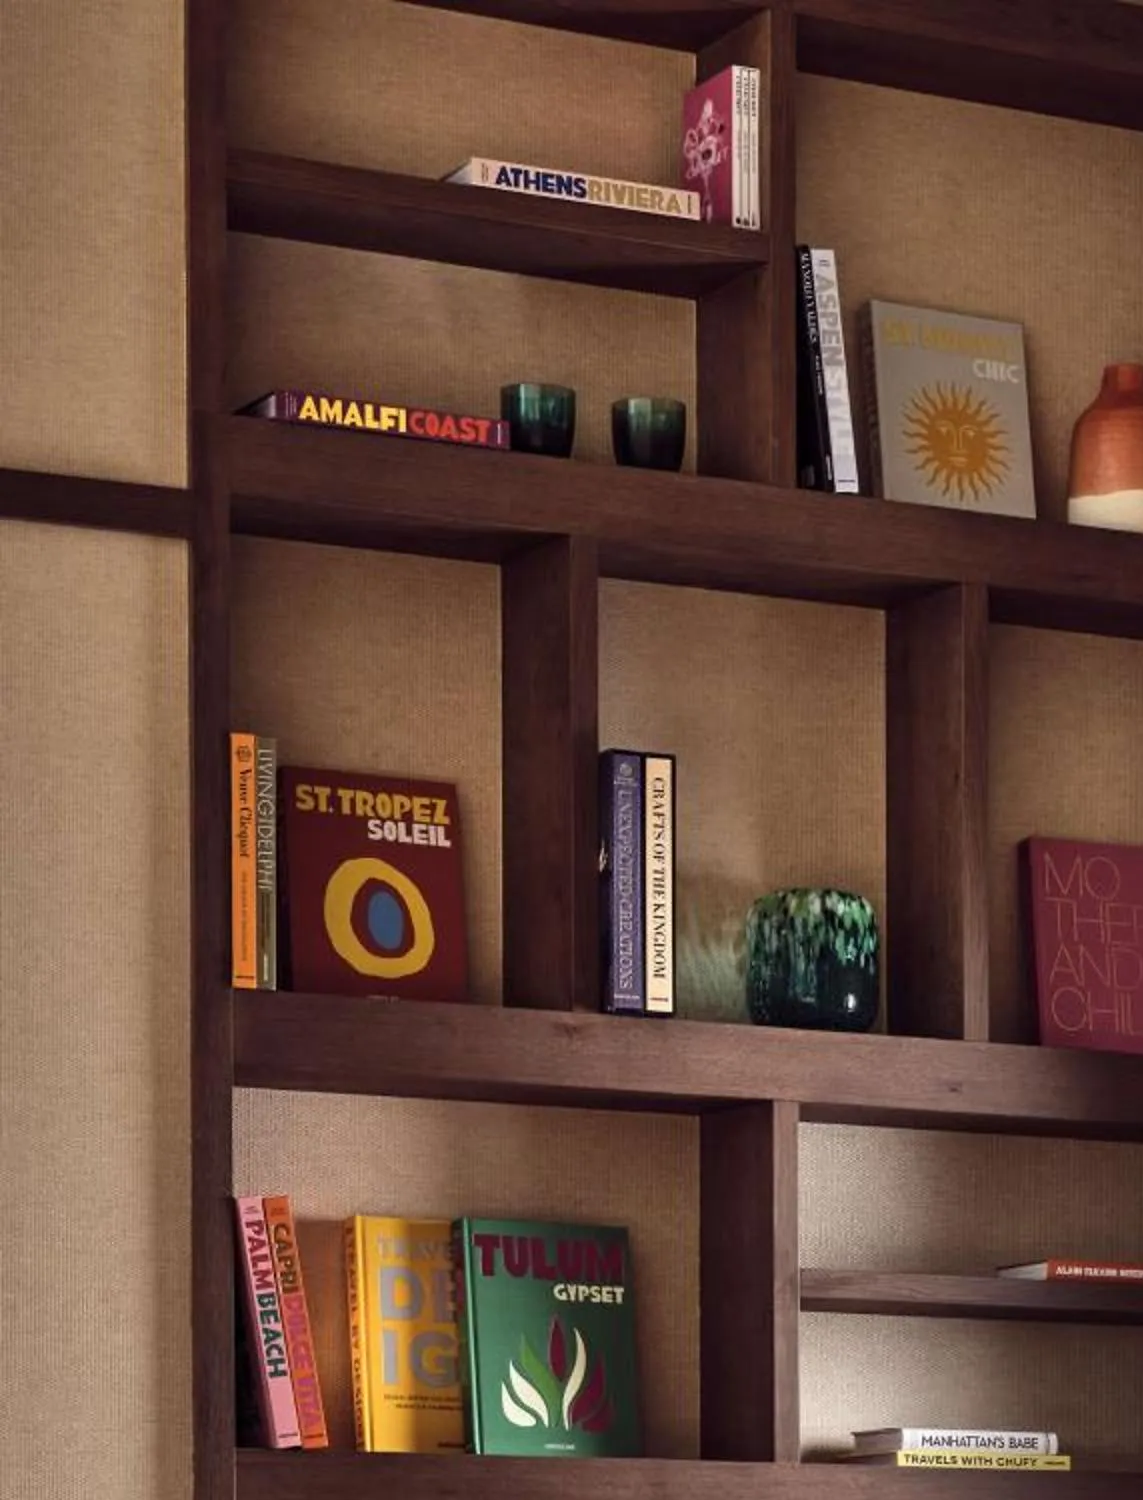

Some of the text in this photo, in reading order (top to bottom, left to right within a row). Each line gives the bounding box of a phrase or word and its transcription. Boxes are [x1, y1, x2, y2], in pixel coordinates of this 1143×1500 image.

[495, 166, 682, 214] ATHENS RIVIERA
[815, 272, 844, 366] ASPEN
[972, 358, 1021, 384] CHIC
[299, 395, 491, 443] AMALFI COAST
[239, 768, 252, 804] Veuve
[295, 784, 450, 825] ST. TROPEZ
[236, 806, 252, 858] Clicquot
[367, 819, 451, 848] SOLEIL
[653, 777, 667, 979] CRAFTS OF THE KINGDOM
[1044, 851, 1121, 901] MO
[617, 898, 634, 990] CREATIONS
[1050, 943, 1143, 991] AND
[274, 1223, 298, 1293] CAPRI
[473, 1233, 625, 1282] TULUM
[245, 1219, 288, 1378] PALM BEACH
[553, 1283, 625, 1304] GYPSET
[904, 1454, 958, 1465] TRAVELS
[961, 1455, 993, 1466] WITH
[996, 1456, 1038, 1467] CHUFY
[921, 1435, 1039, 1449] MANHATTAN'S BABE
